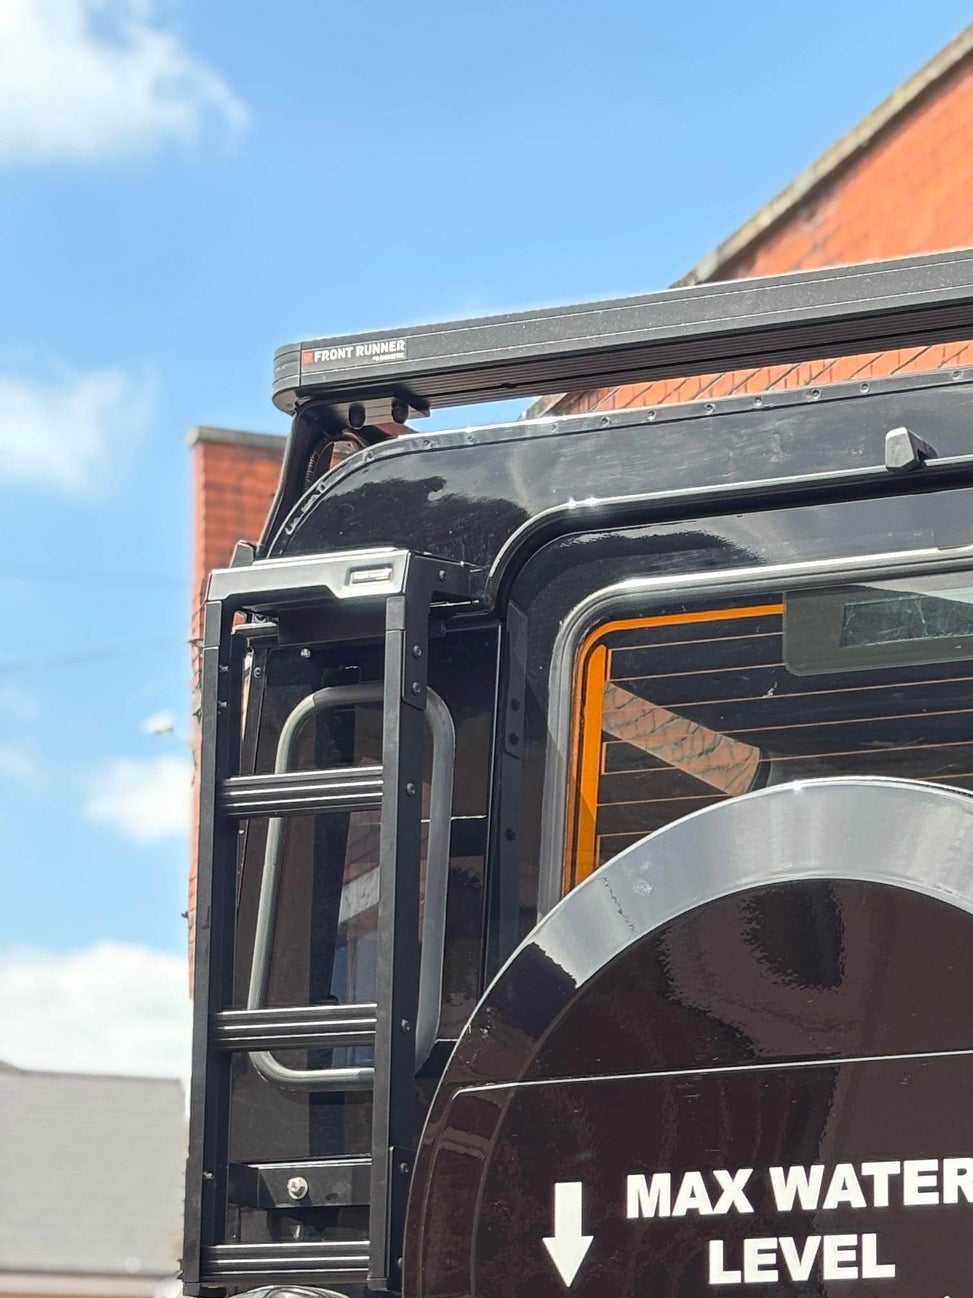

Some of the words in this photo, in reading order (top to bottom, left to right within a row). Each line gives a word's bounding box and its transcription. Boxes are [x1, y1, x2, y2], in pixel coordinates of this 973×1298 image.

[313, 346, 354, 363] FRONT
[355, 340, 405, 358] RUNNER
[626, 1168, 754, 1219] MAX
[708, 1233, 896, 1285] LEVEL
